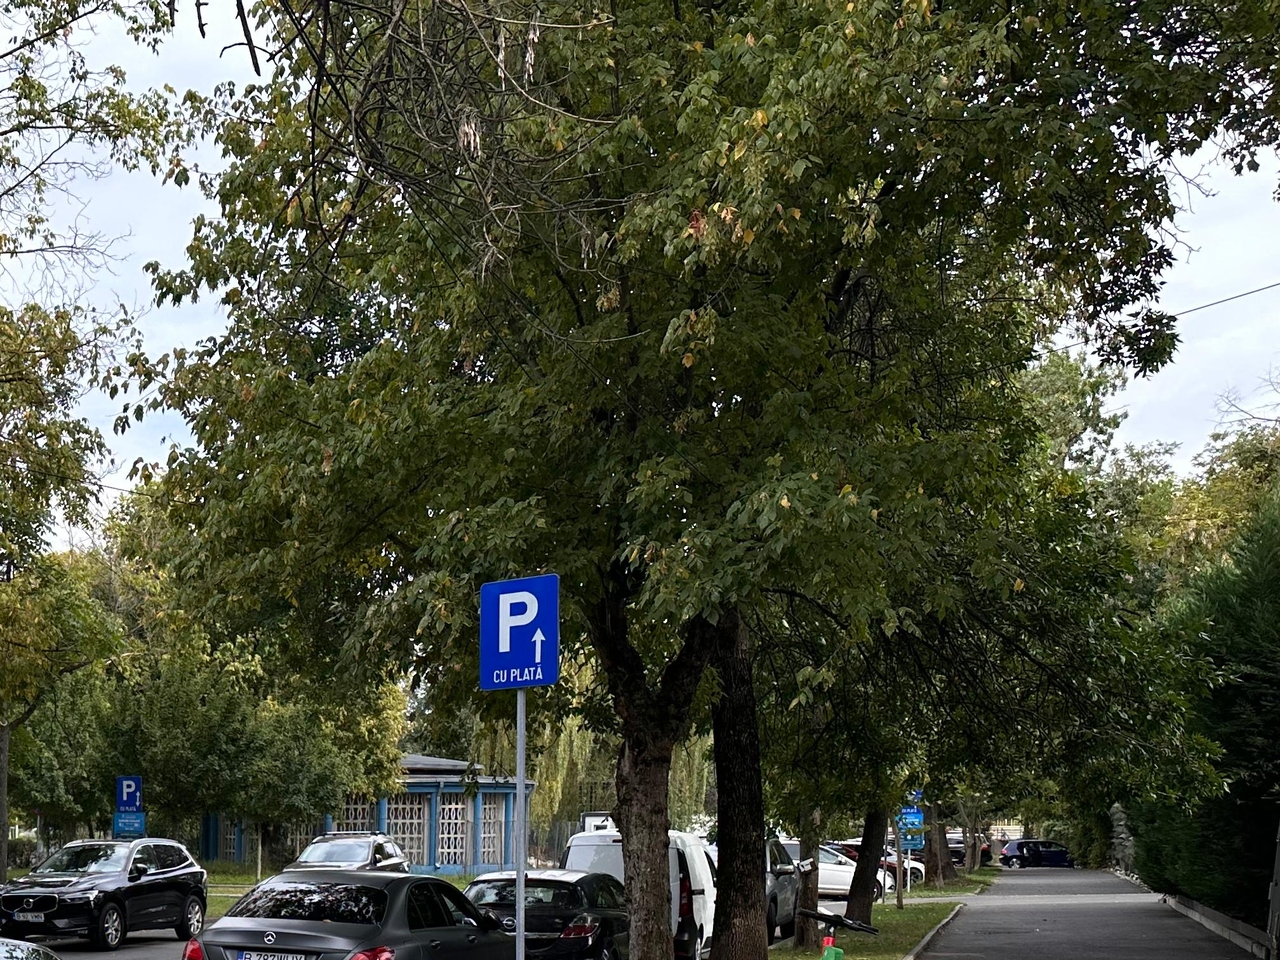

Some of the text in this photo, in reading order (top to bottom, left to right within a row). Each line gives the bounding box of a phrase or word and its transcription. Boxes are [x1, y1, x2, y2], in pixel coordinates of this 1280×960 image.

[499, 591, 538, 653] P
[493, 665, 543, 683] CU PLATĂ
[122, 780, 136, 801] P
